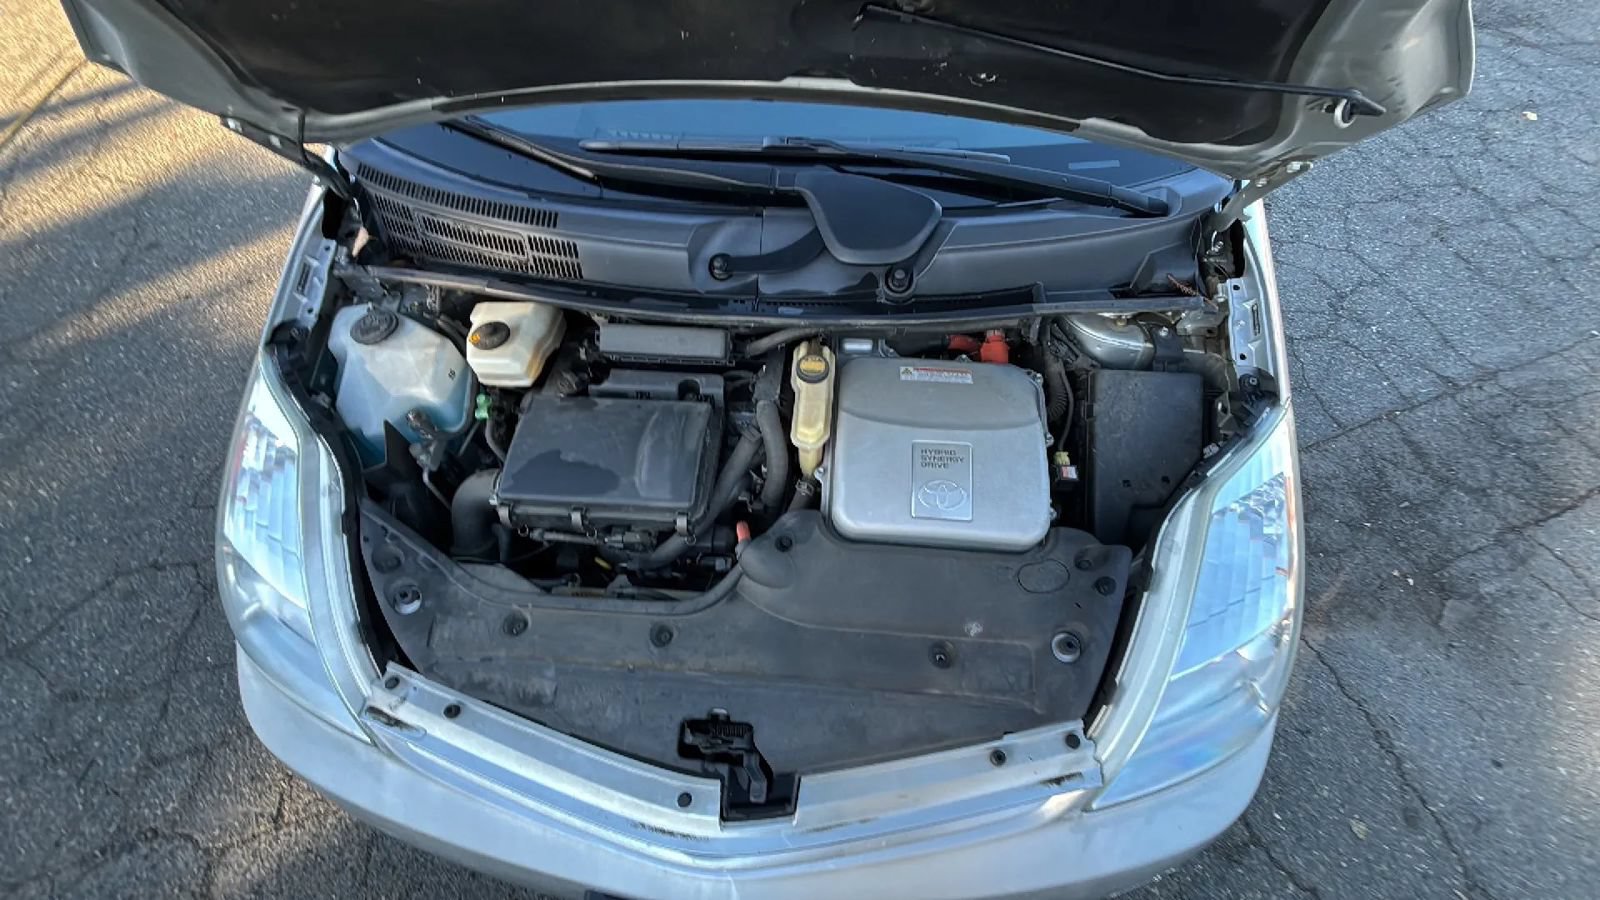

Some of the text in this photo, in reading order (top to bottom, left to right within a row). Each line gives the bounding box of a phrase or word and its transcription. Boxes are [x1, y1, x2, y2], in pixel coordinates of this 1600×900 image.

[920, 448, 957, 456] HYBRID
[920, 455, 965, 463] SYNERGY
[920, 461, 950, 469] DRIVE
